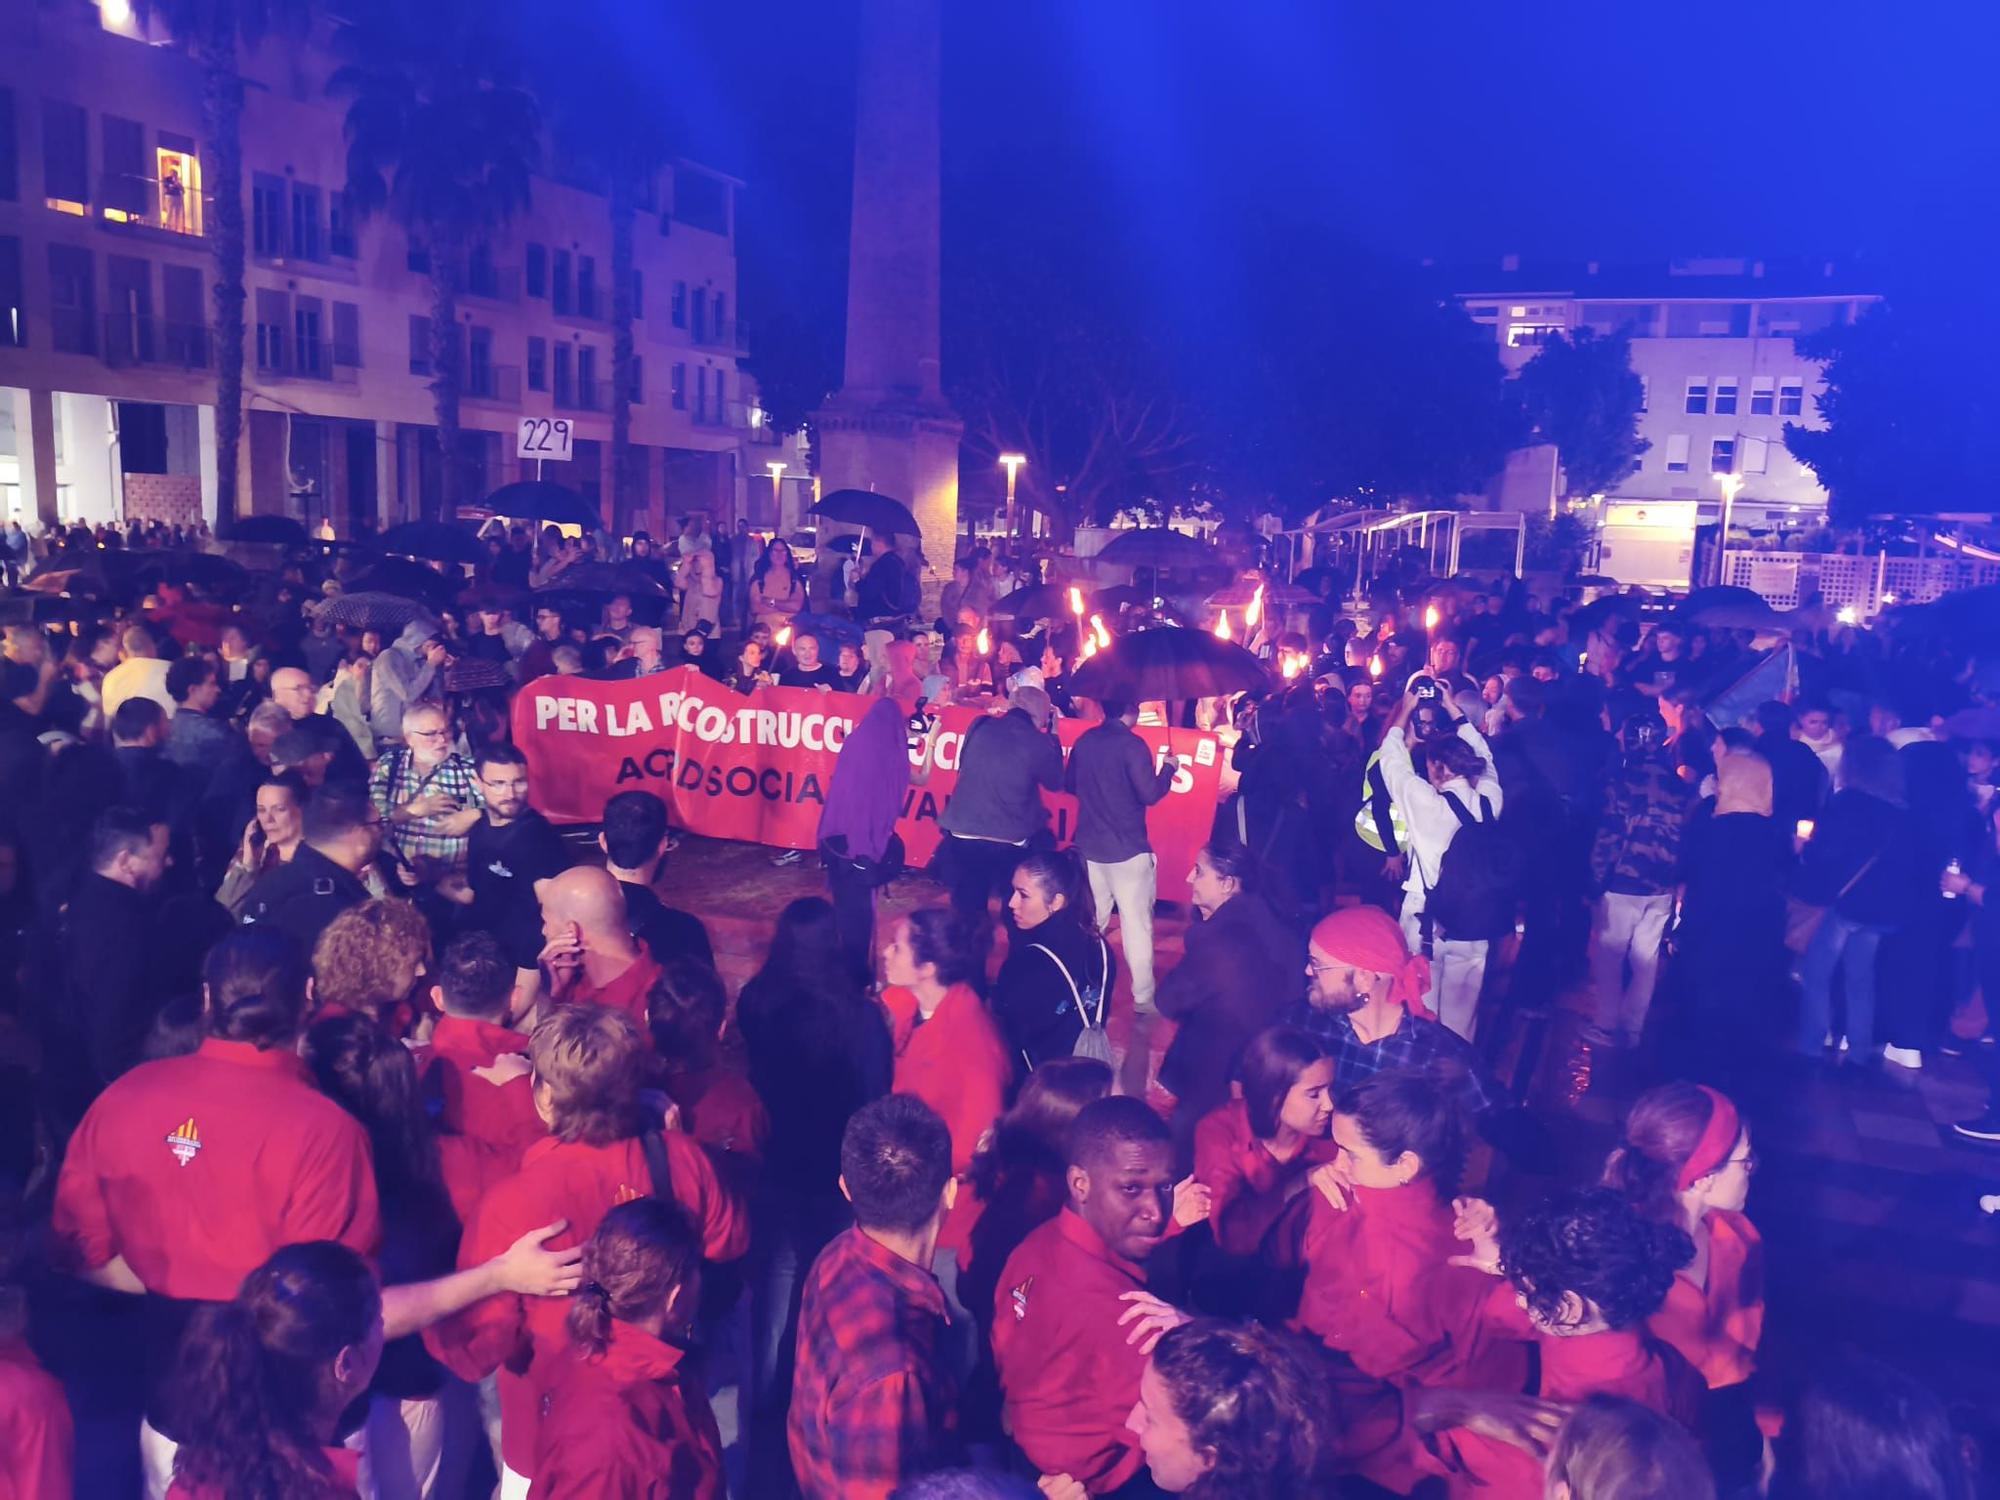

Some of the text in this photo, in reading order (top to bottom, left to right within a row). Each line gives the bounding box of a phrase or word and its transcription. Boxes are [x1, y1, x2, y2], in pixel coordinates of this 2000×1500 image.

[523, 418, 569, 452] 229
[535, 696, 599, 735] PER
[605, 700, 654, 737] LA
[705, 765, 832, 805] SOCIA
